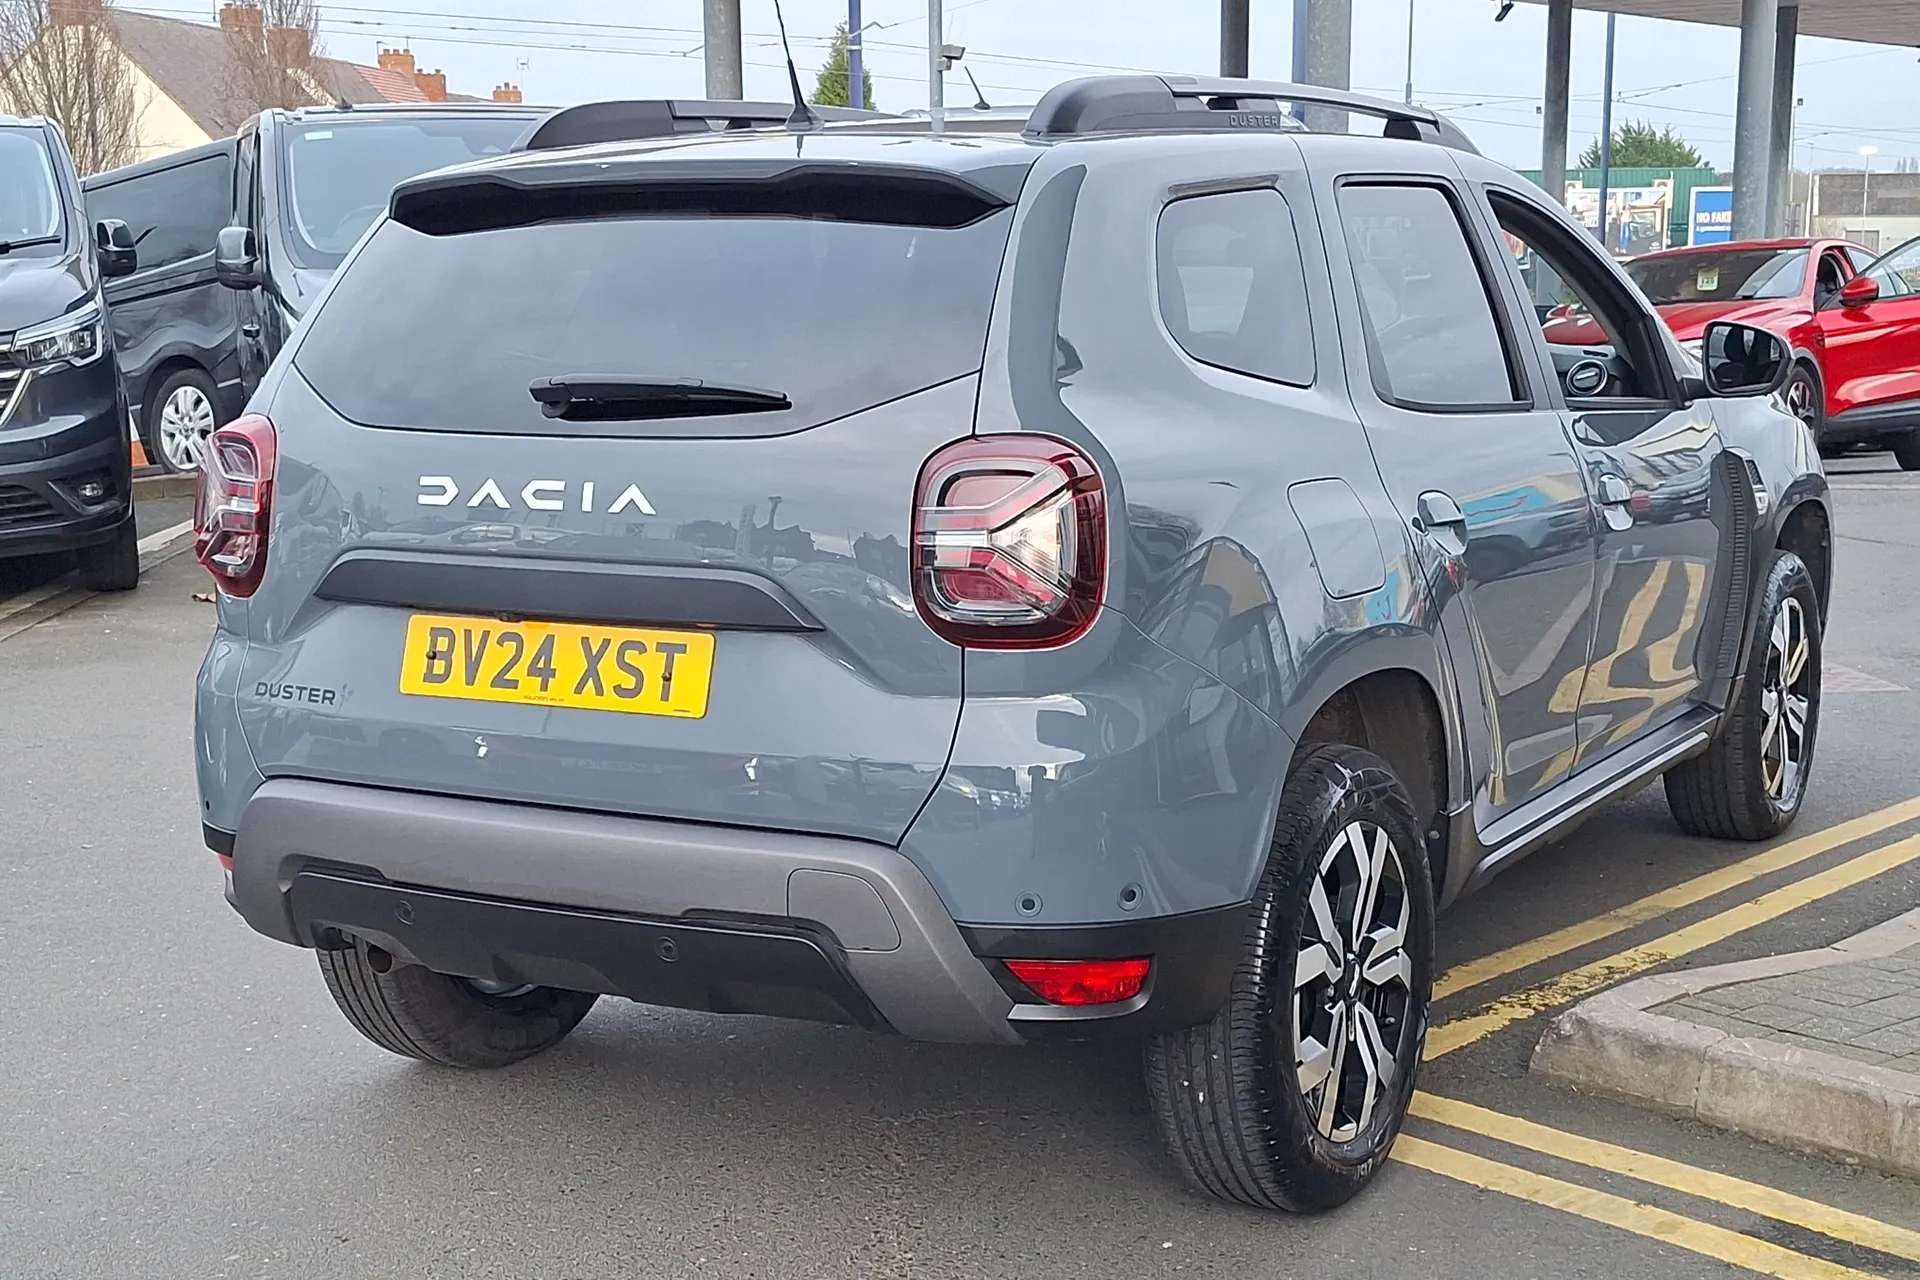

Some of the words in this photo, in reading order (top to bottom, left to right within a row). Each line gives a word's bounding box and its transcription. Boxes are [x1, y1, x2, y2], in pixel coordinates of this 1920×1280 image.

[1230, 114, 1279, 128] DUSTER
[1696, 211, 1710, 224] NO
[417, 475, 657, 515] DACIA
[422, 626, 556, 692] BV24
[573, 636, 688, 702] XST
[254, 681, 336, 706] DUSTER
